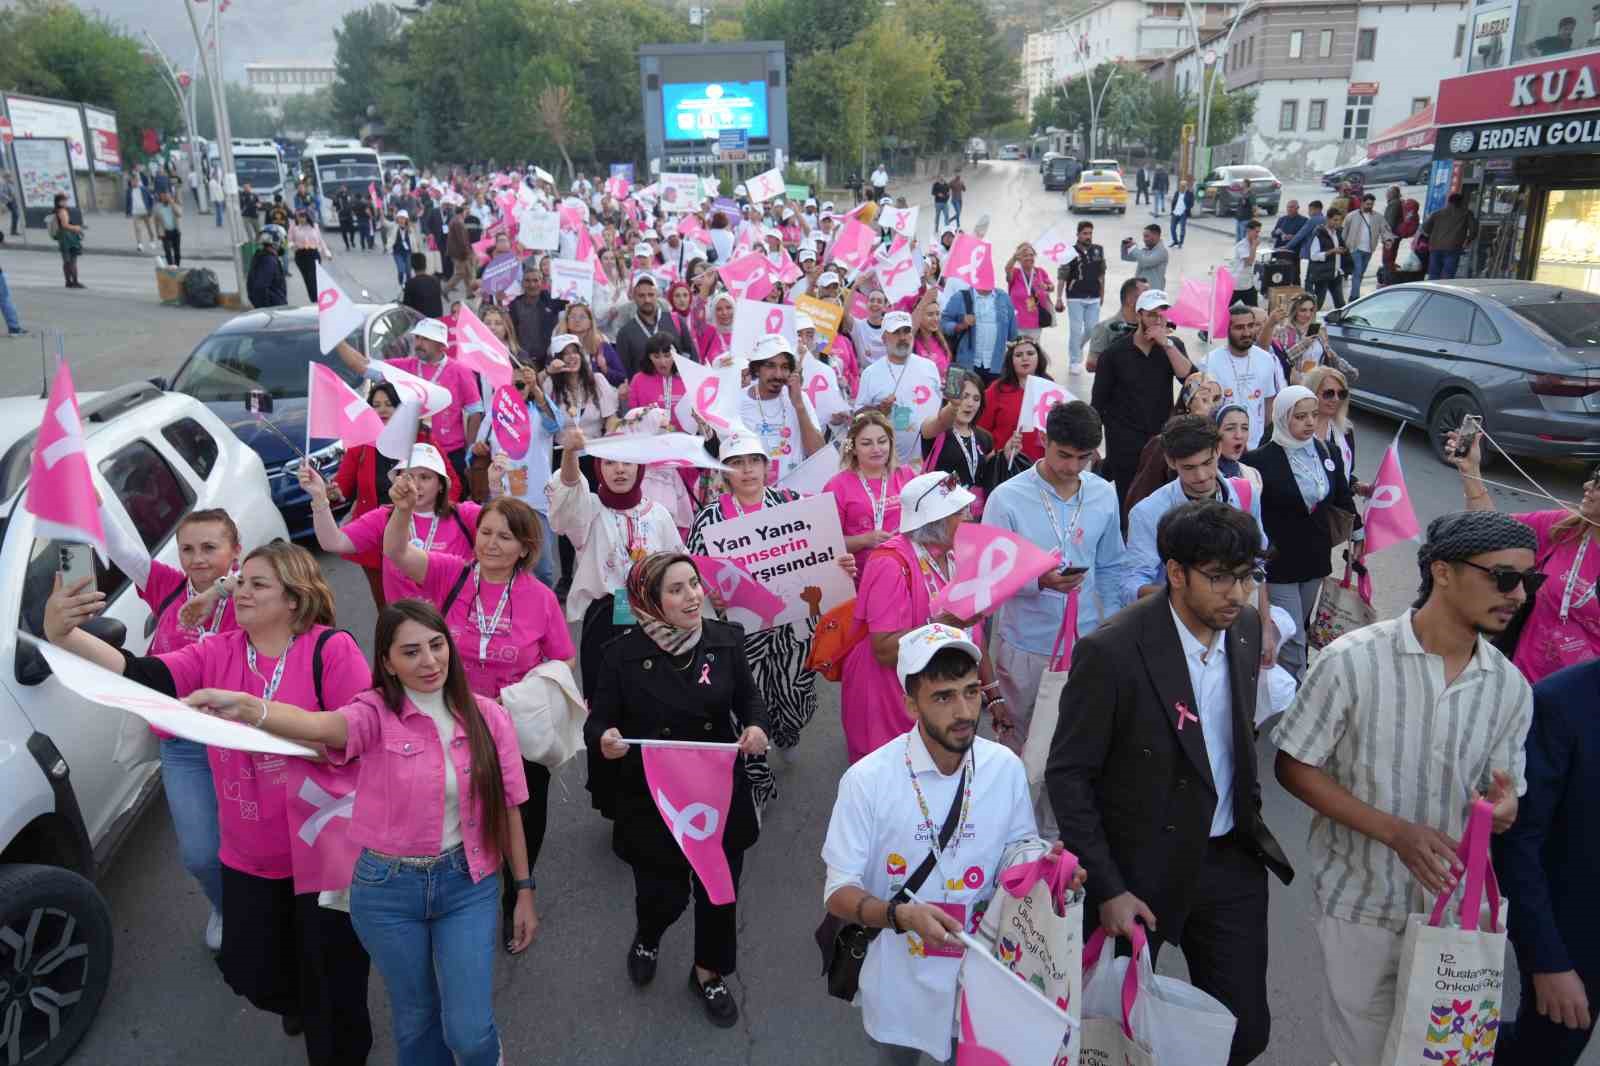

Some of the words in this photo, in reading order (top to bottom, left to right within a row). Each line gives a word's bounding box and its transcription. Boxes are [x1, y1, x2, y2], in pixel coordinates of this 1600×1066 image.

[1478, 125, 1541, 150] ERDEN
[713, 535, 751, 553] Yan
[755, 520, 812, 541] Yana,
[751, 546, 835, 583] rşısında!
